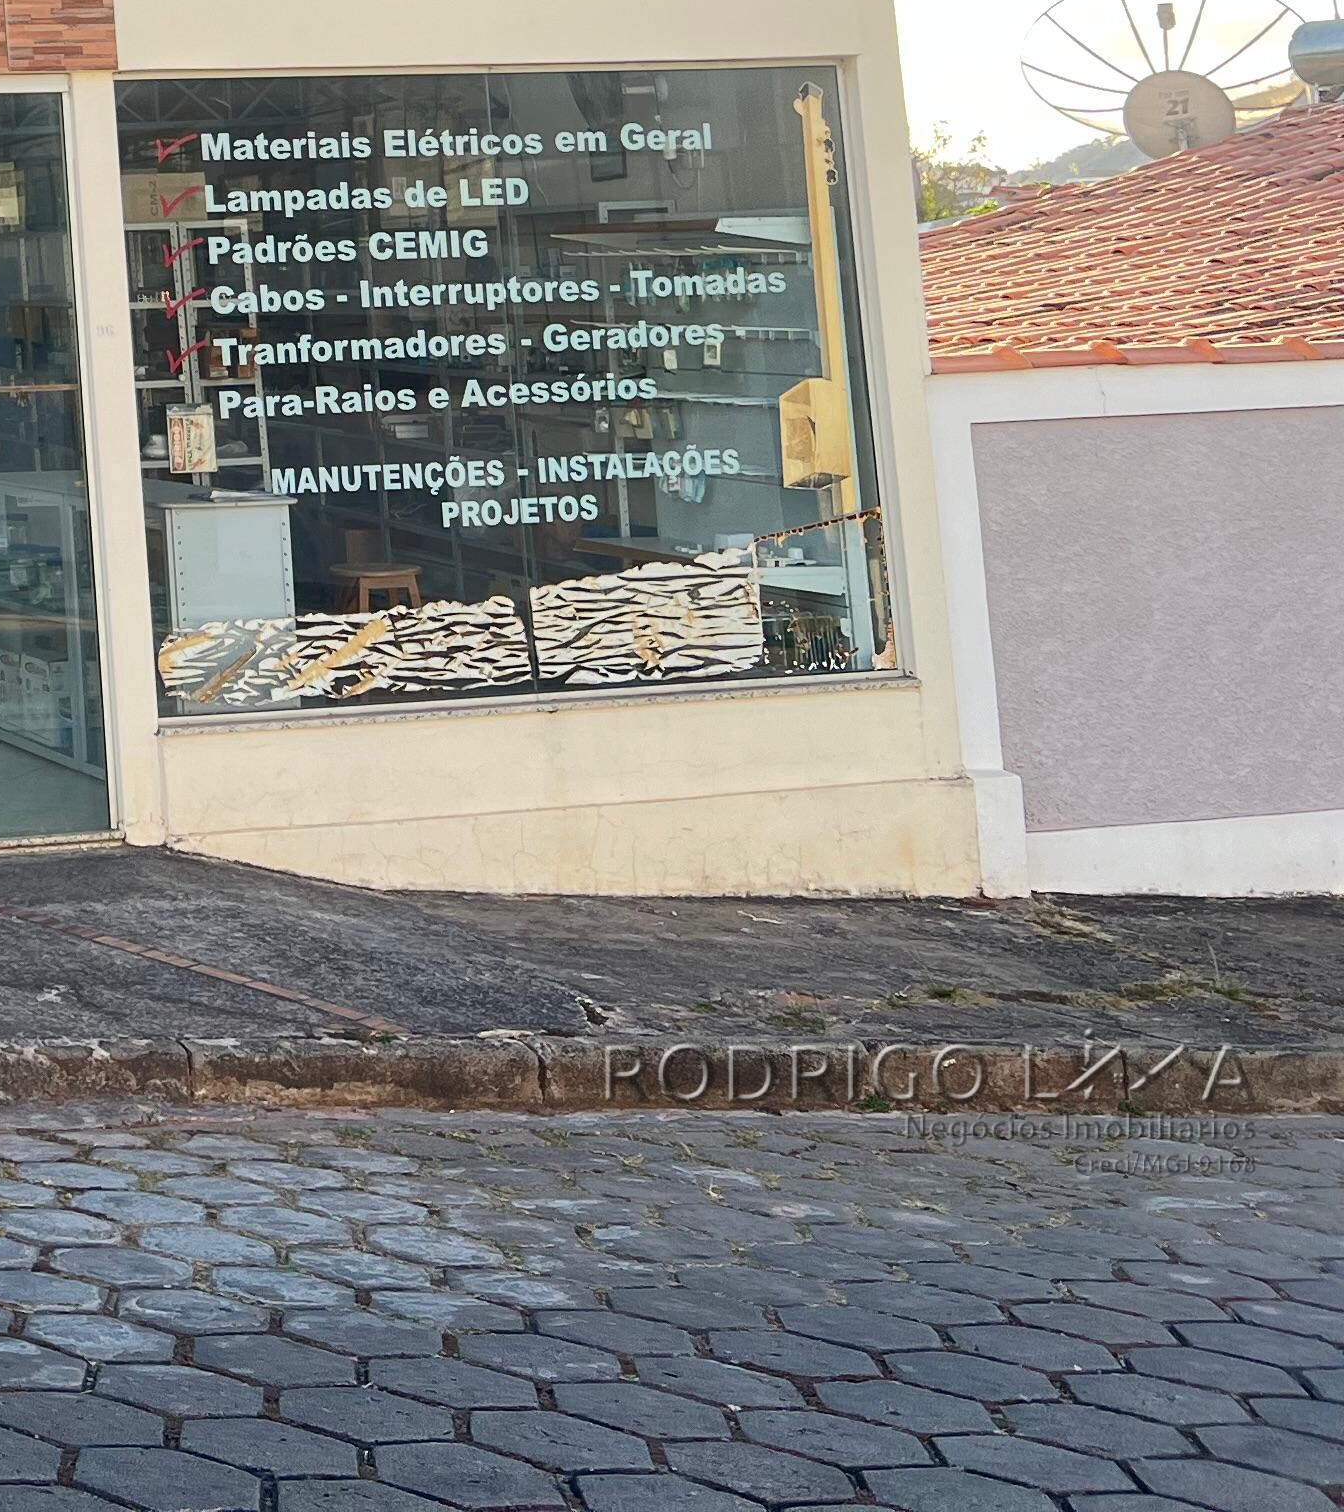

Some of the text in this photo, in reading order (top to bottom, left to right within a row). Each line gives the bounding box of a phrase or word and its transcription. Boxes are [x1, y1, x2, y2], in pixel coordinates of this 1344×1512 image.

[1166, 98, 1189, 116] 21
[201, 122, 712, 161] Materiais Elétricos em Geral
[205, 177, 529, 218] Lampadas de LED
[207, 229, 489, 265] Padrões CEMIG
[210, 284, 325, 315] Cabos
[359, 275, 600, 311] Interruptores
[629, 266, 786, 299] Tomadas
[213, 330, 507, 366] Tranformadores
[543, 320, 725, 350] Geradores
[218, 372, 658, 419] Para-Raios e Acessórios
[271, 455, 505, 496] MANUTENÇÕES
[537, 444, 740, 483] INSTALAÇÕES
[441, 494, 598, 528] PROJETOS
